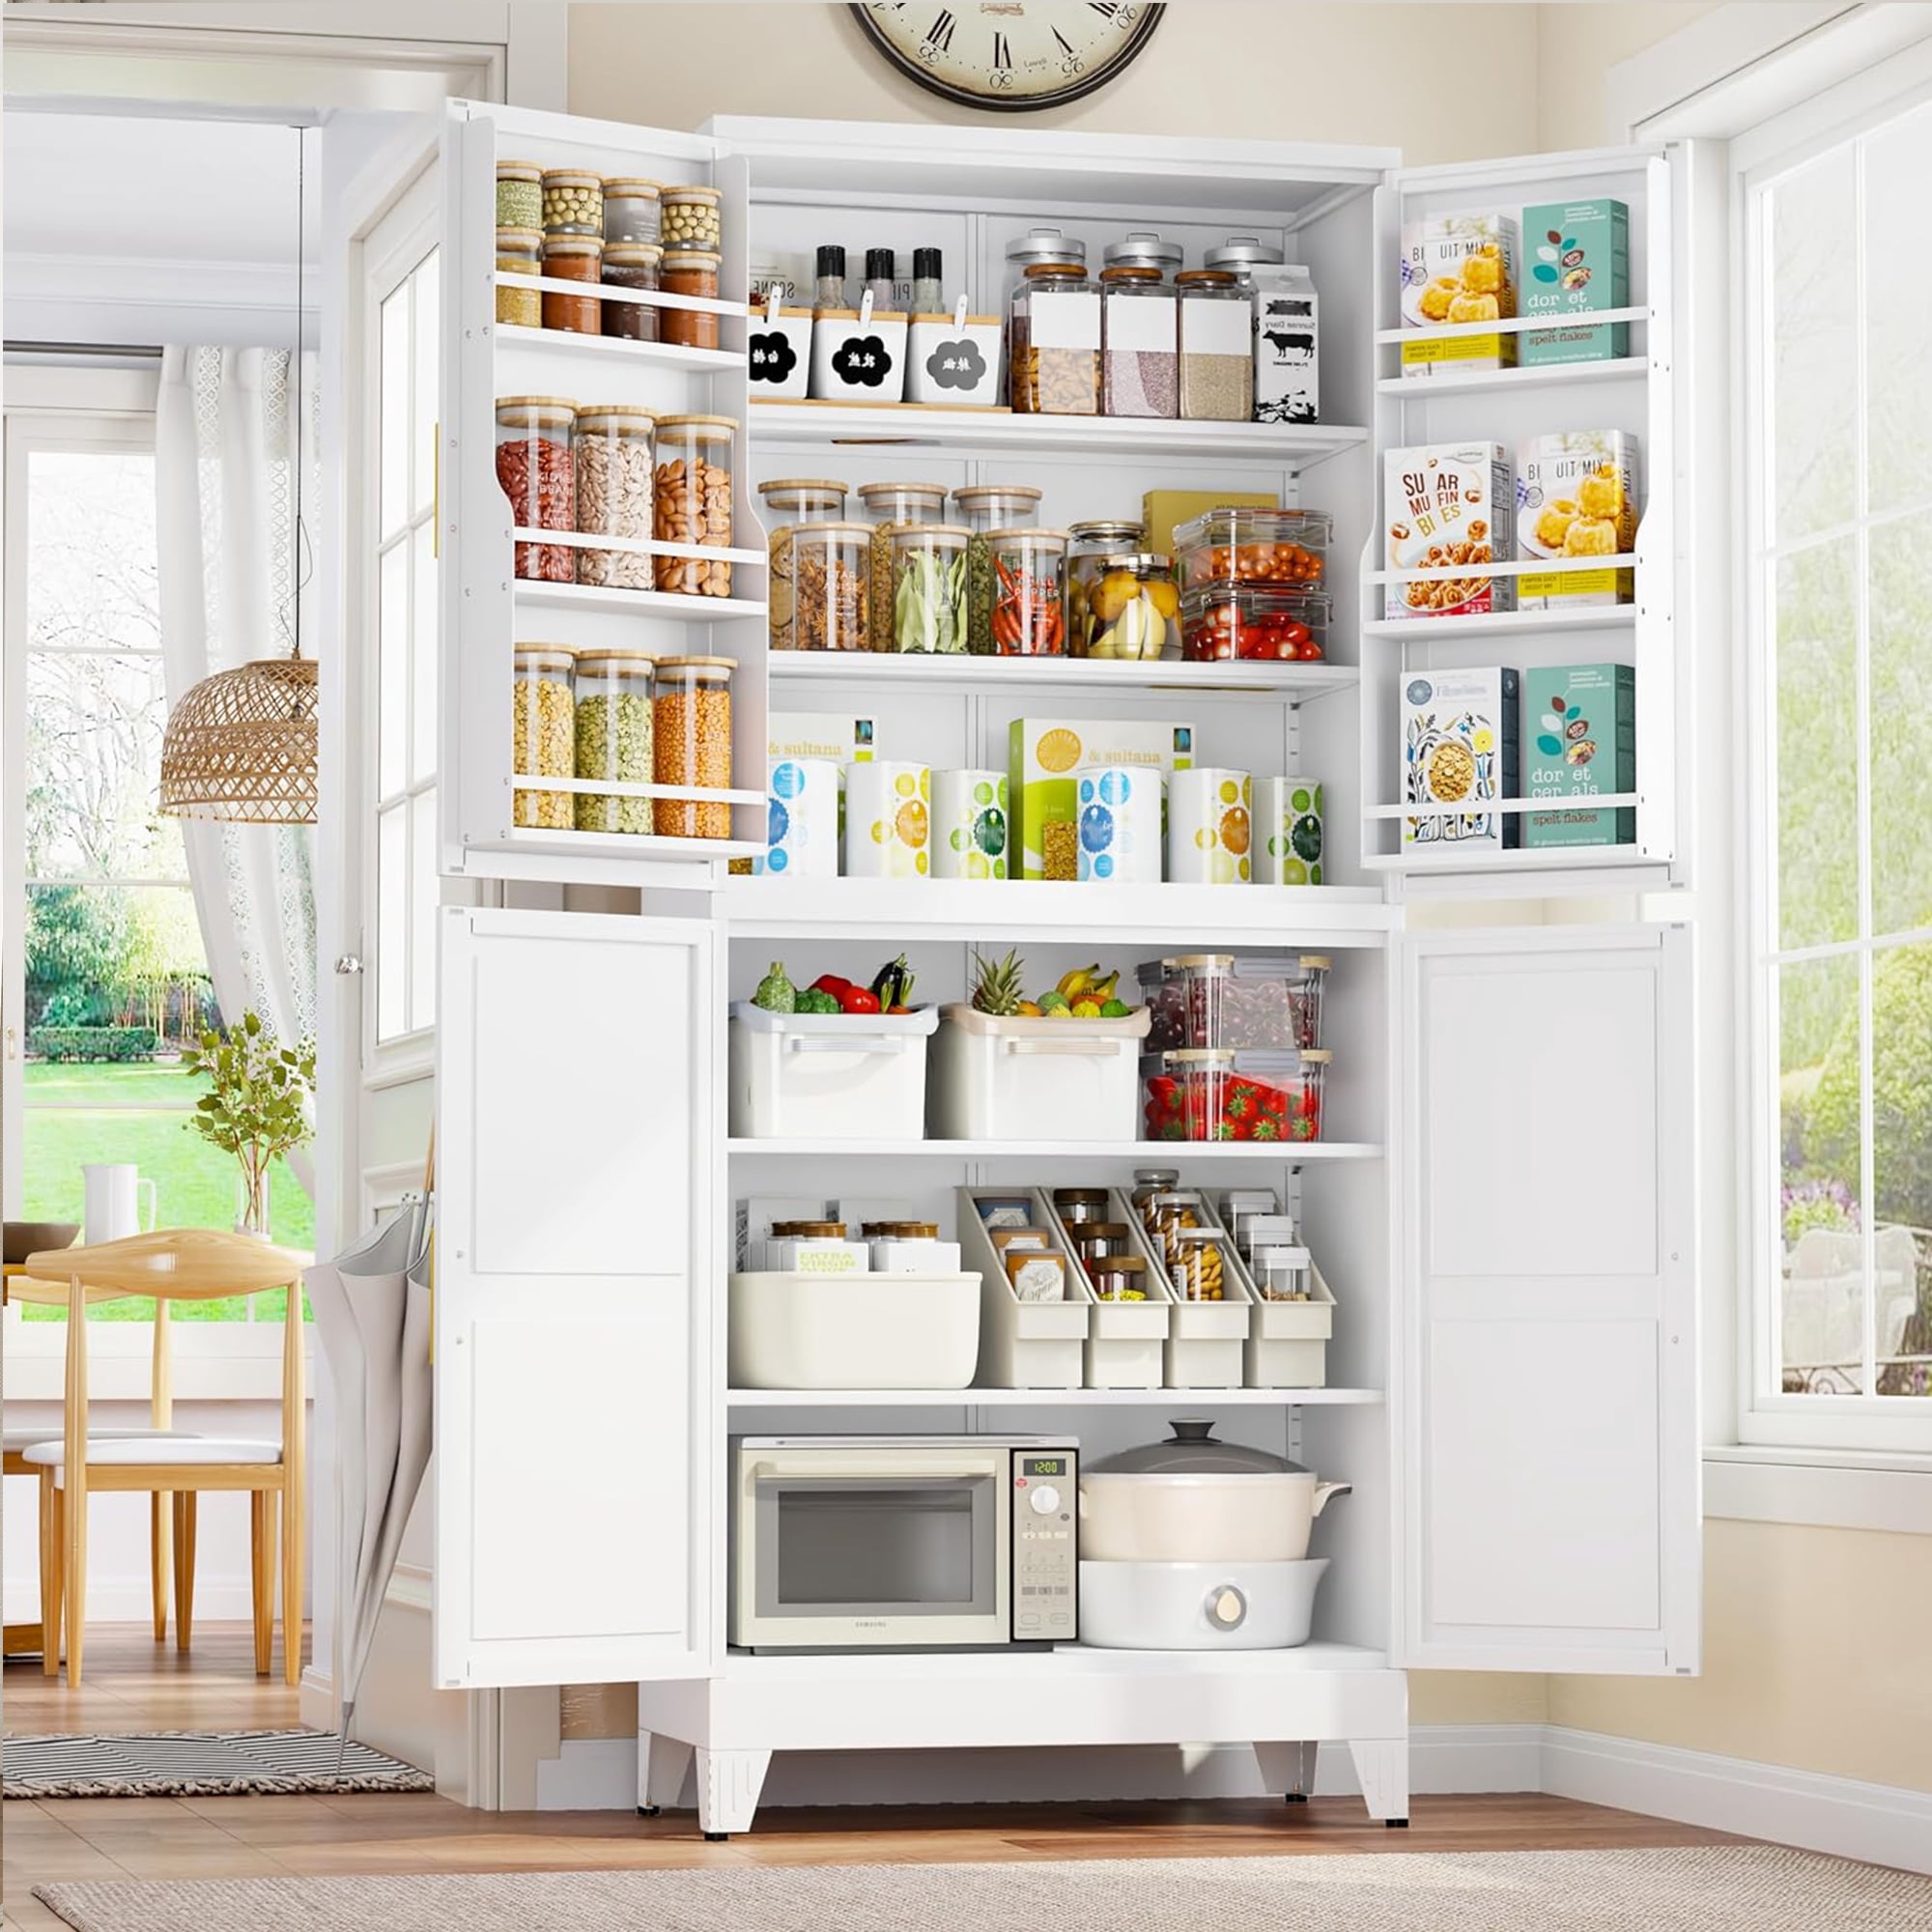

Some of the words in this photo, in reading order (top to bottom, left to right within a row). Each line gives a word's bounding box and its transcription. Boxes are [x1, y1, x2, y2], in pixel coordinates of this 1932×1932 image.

[1465, 240, 1486, 256] MIX
[1527, 294, 1560, 308] dor
[1568, 291, 1588, 304] et
[1527, 464, 1541, 480] BI
[1556, 460, 1577, 478] UIT
[1582, 458, 1604, 475] MIX
[1402, 472, 1425, 497] SU
[1436, 473, 1460, 491] AR
[1408, 495, 1431, 517] MU
[1436, 491, 1459, 506] FIN
[1416, 514, 1436, 537] BI
[1440, 504, 1461, 523] ES
[1531, 768, 1564, 783] dor
[1573, 765, 1592, 781] et
